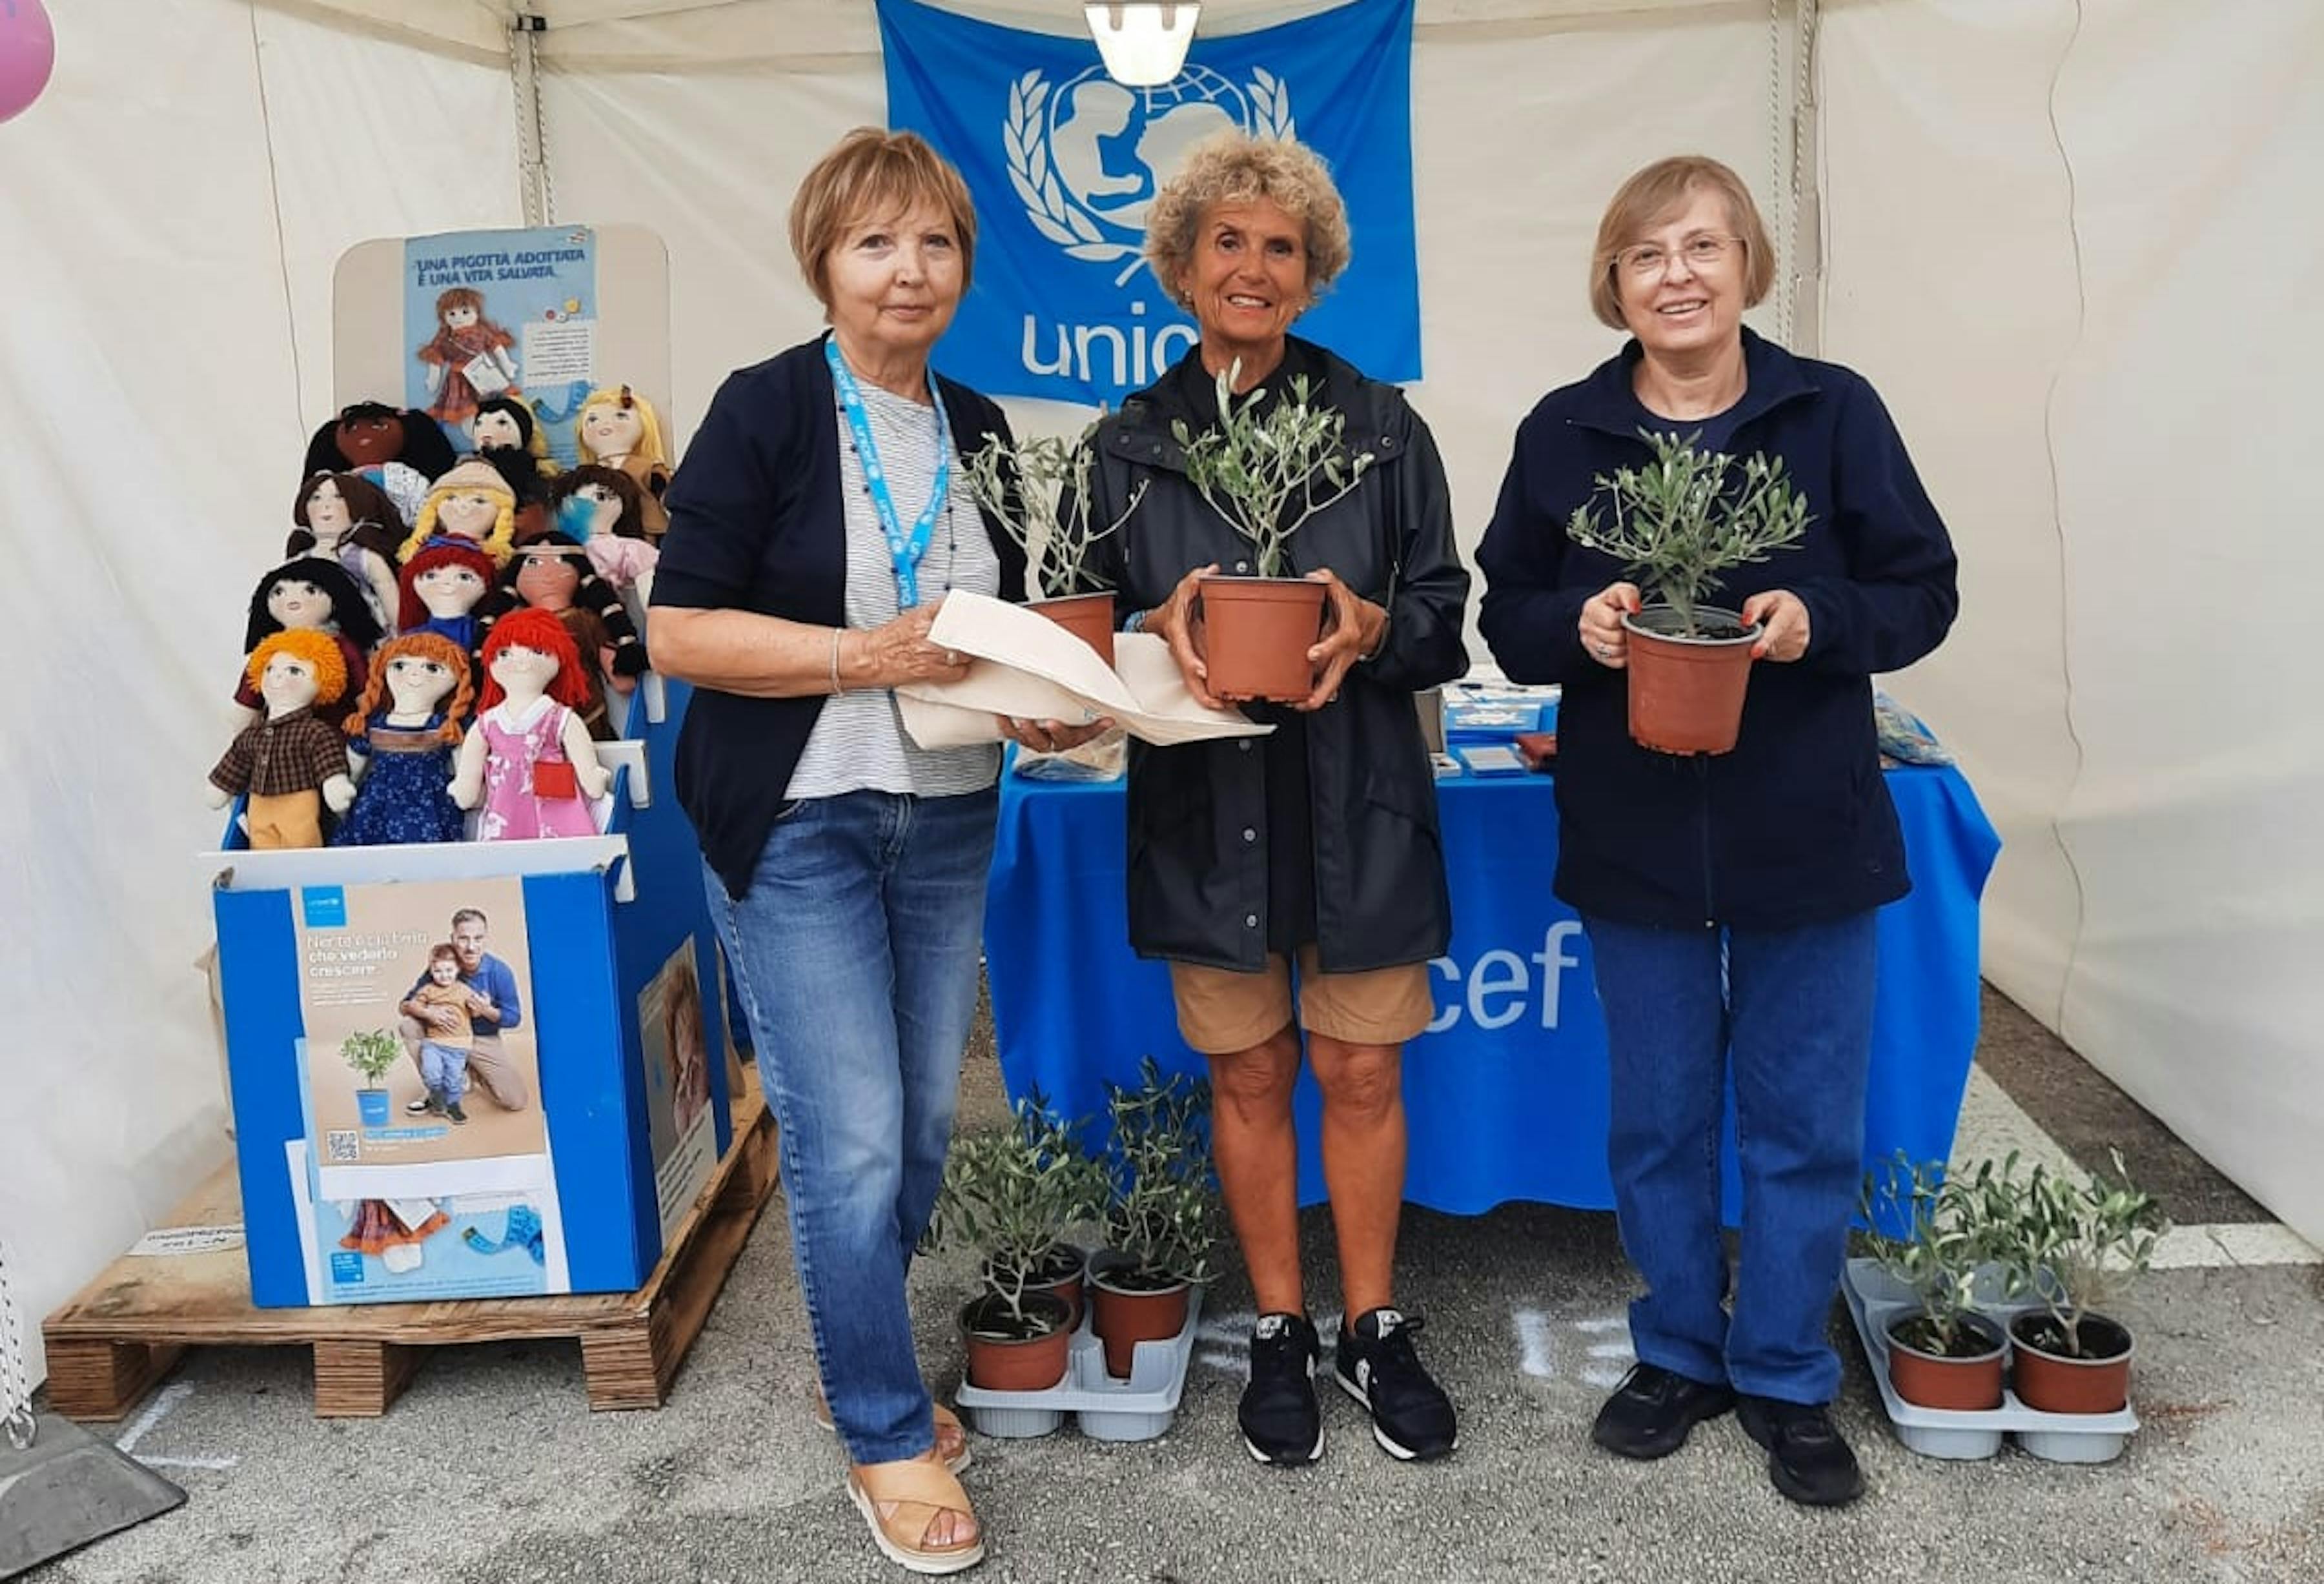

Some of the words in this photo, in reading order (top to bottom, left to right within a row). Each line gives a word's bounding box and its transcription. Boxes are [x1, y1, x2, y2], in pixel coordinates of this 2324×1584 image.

[417, 259, 448, 272] UNA
[453, 253, 510, 269] PIGOTTA
[515, 249, 586, 264] ADOTTATA
[429, 272, 460, 285] UNA
[465, 269, 493, 283] VITA
